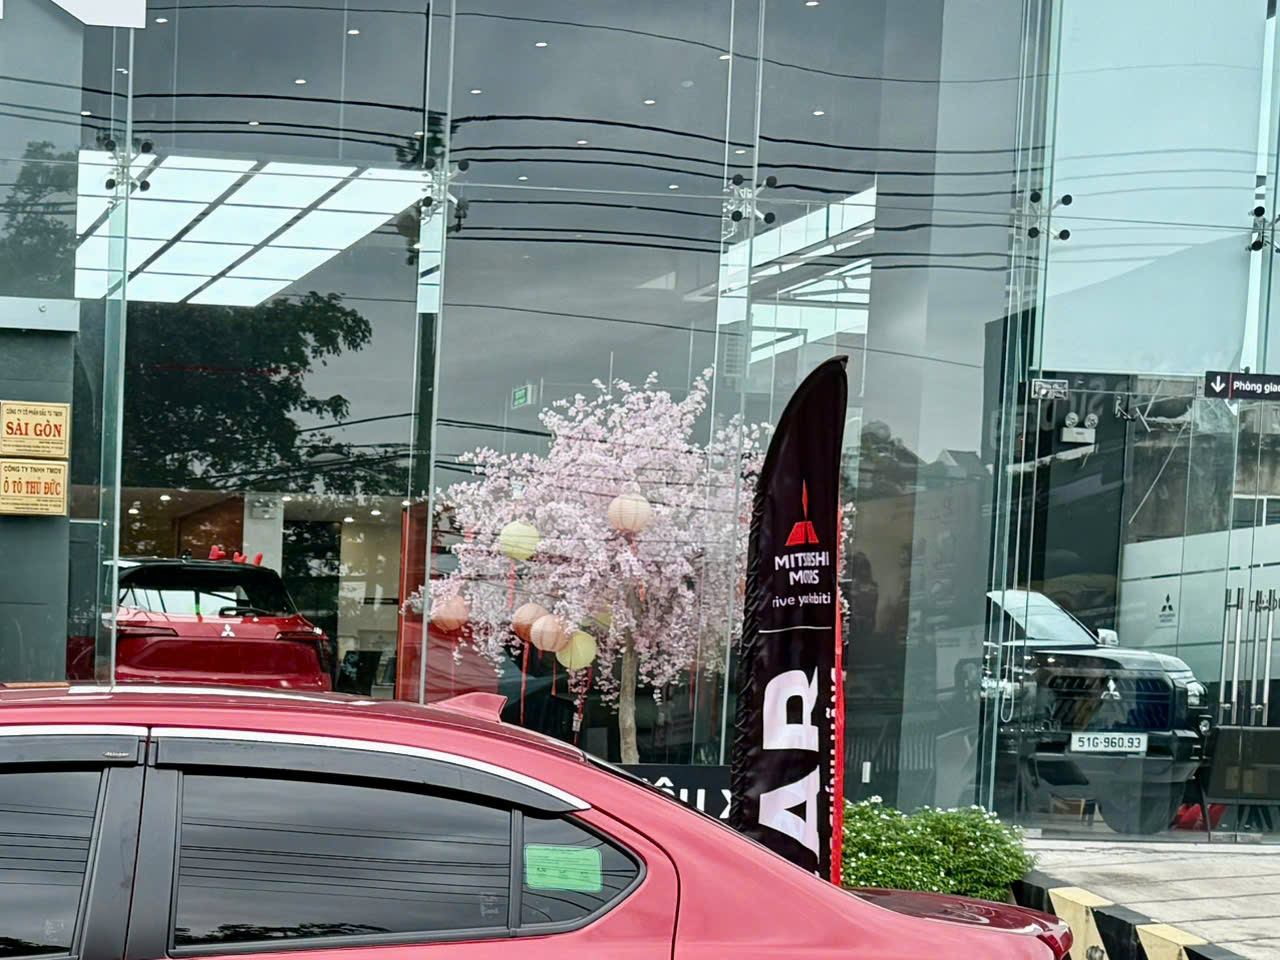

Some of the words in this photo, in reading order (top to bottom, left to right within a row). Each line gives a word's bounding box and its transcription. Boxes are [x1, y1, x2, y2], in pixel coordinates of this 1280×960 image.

[1233, 380, 1262, 394] Phòng
[6, 418, 29, 436] SÀI
[33, 419, 62, 438] GÒN
[3, 464, 20, 472] CÔNG
[3, 476, 9, 493] Ô
[12, 477, 22, 494] TÔ
[44, 478, 61, 496] ĐỨC
